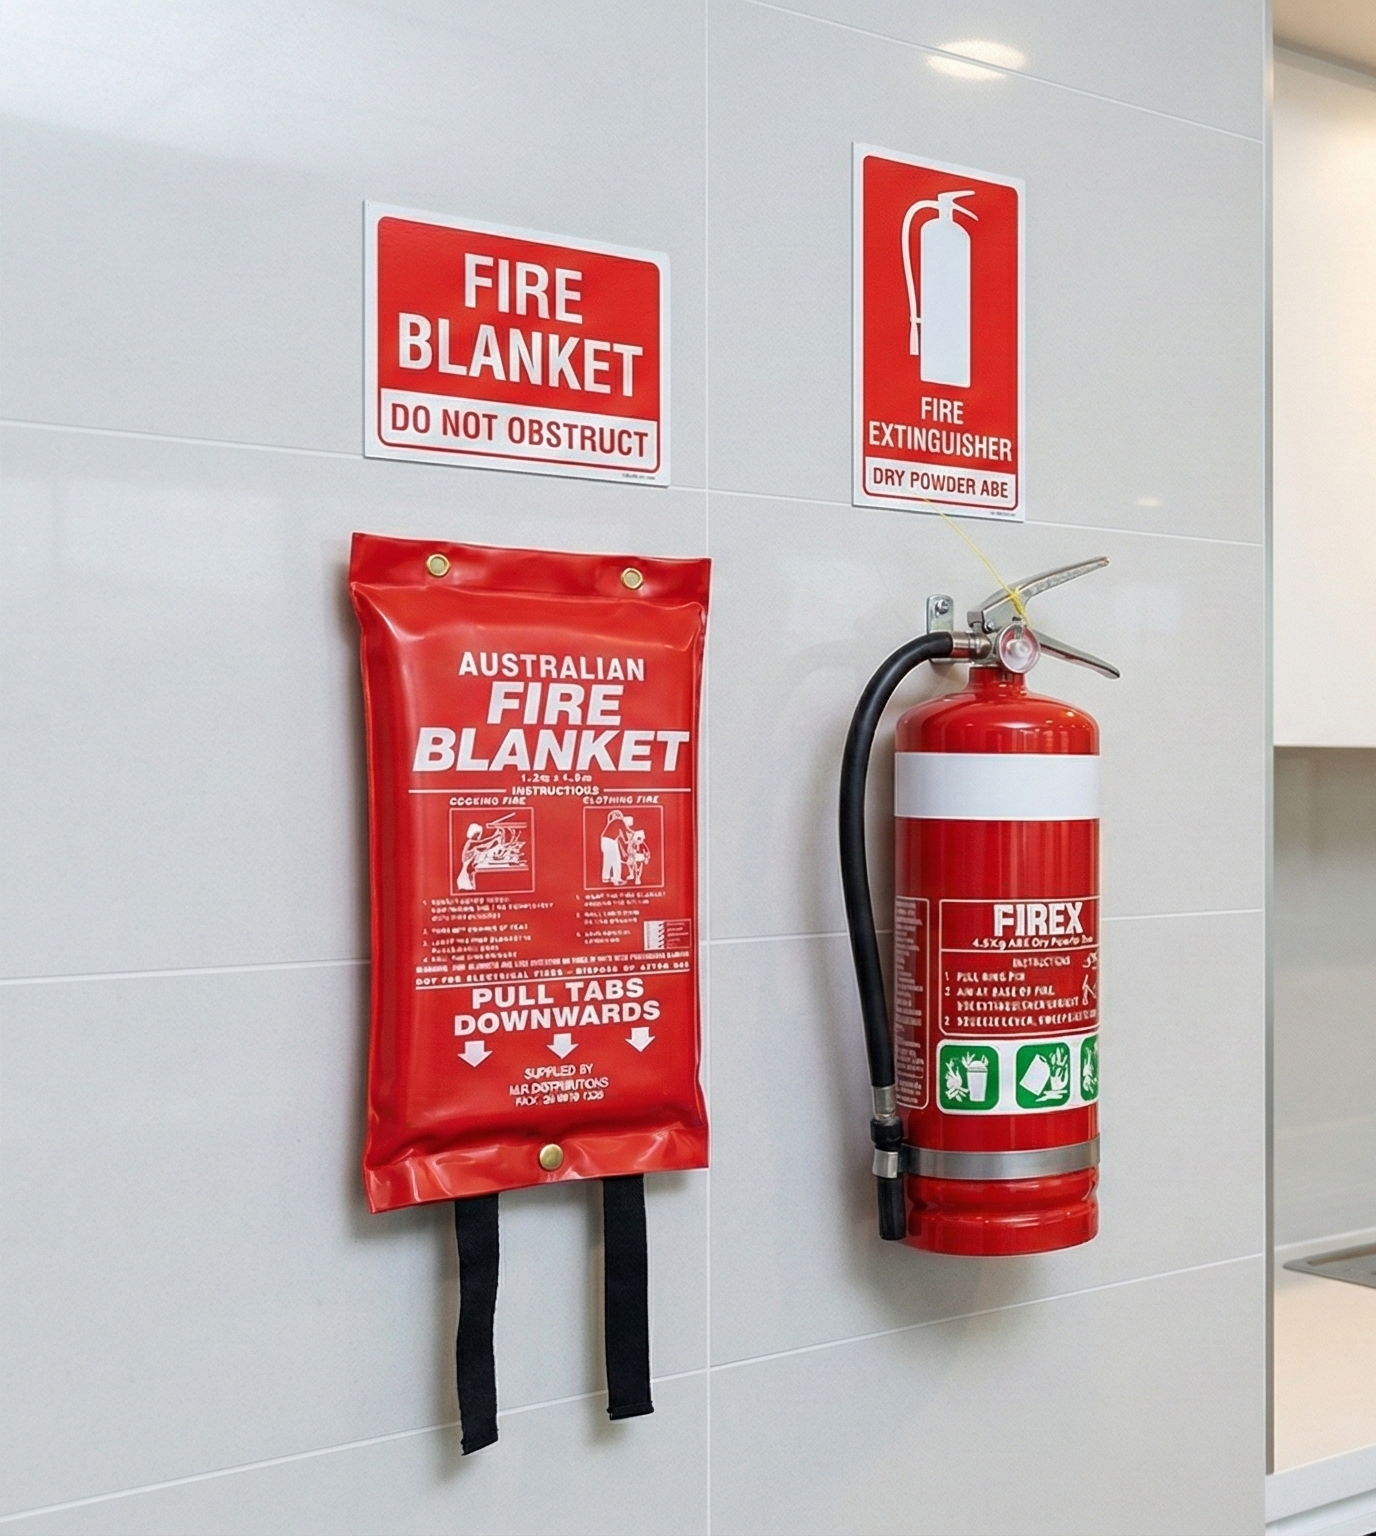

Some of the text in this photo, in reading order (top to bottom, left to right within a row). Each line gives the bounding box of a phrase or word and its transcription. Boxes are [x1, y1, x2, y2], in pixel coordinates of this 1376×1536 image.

[464, 252, 583, 325] FIRE
[399, 311, 643, 398] BLANKET
[921, 396, 964, 425] FIRE
[391, 402, 649, 458] DO NOT OBSTRUCT
[869, 420, 1012, 462] EXTINGUISHER
[873, 467, 1008, 499] DRY POWDER ABE
[458, 651, 645, 682] AUSTRALIAN
[487, 681, 624, 726] FIRE
[412, 727, 690, 772] BLANKET
[993, 902, 1084, 937] FIREX
[472, 978, 644, 1009] PULL TABS
[454, 1000, 660, 1036] DOWNWARDS
[579, 1063, 594, 1075] BY
